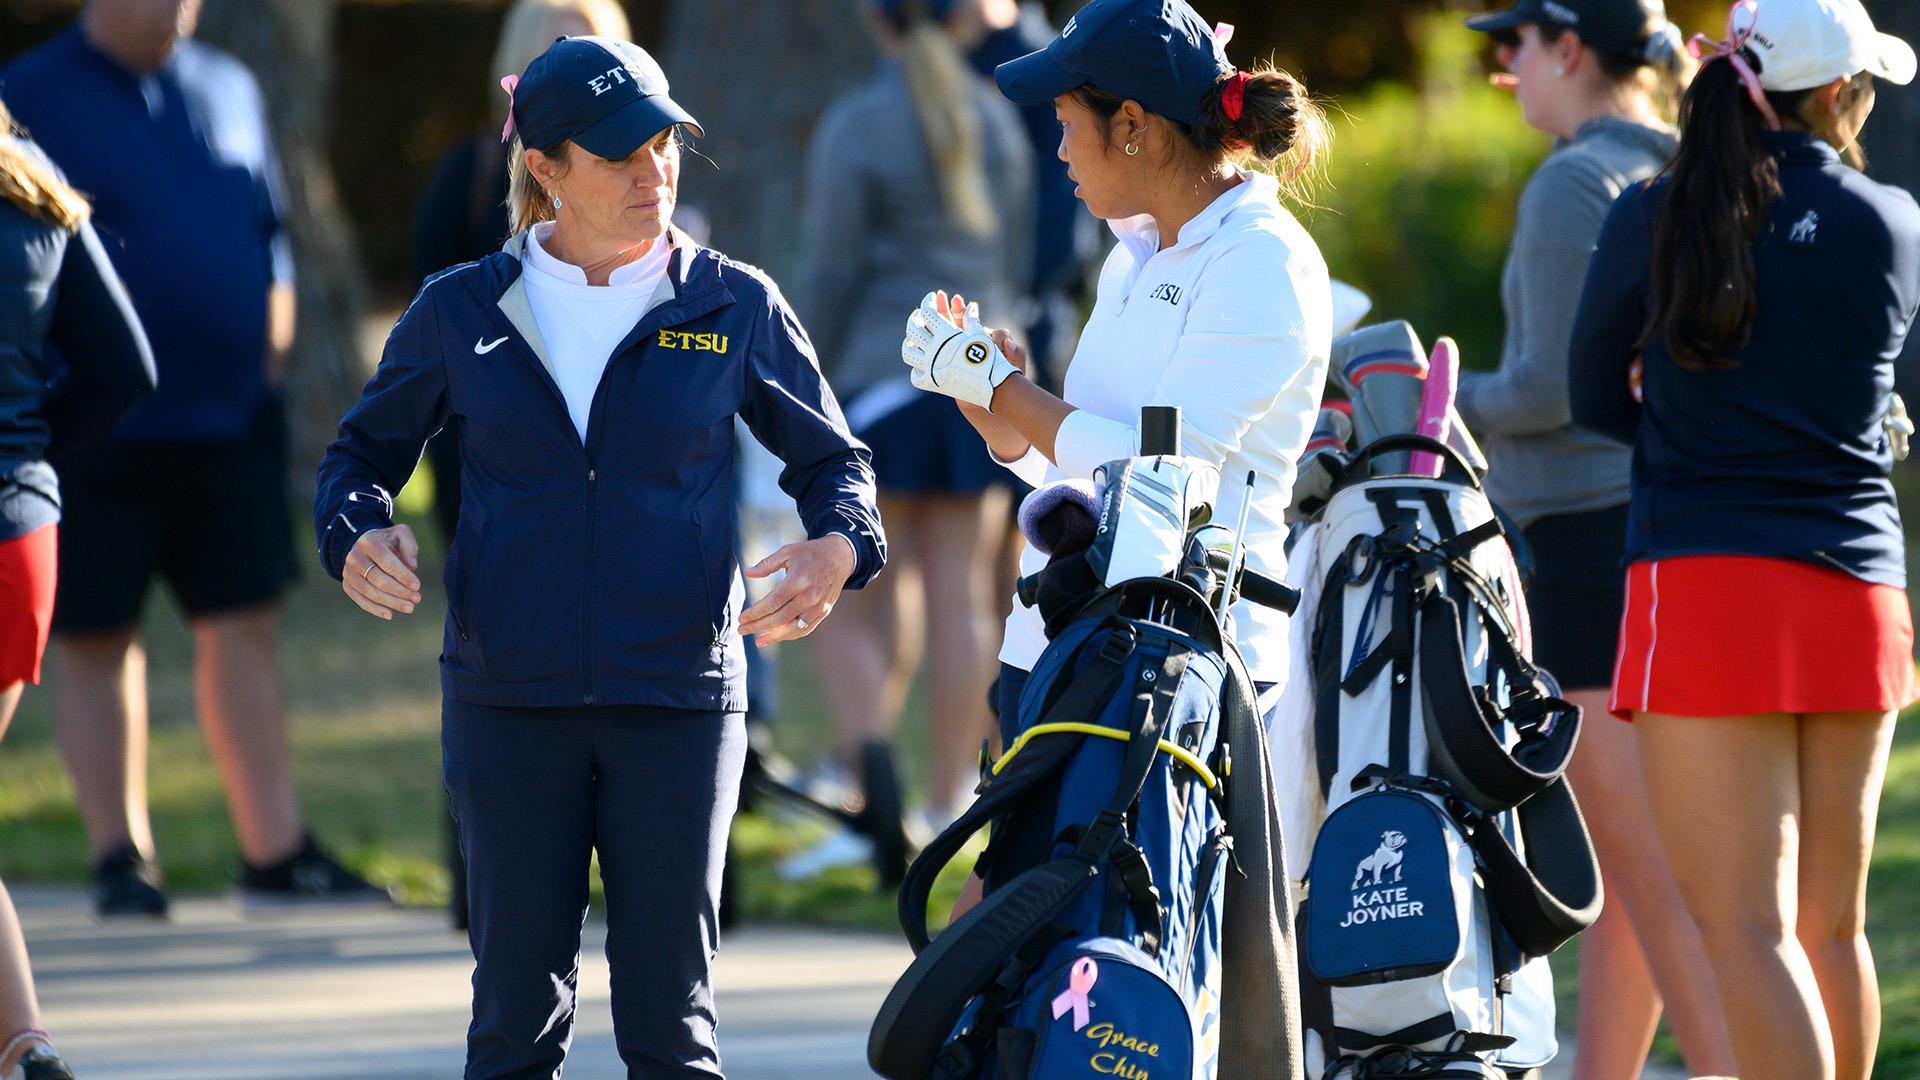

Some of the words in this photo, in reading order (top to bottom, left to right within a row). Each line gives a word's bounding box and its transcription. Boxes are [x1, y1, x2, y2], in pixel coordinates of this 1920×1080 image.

[1149, 283, 1184, 306] ETSU
[658, 329, 729, 354] ETSU
[1352, 887, 1408, 909] KATE
[1340, 901, 1424, 928] JOYNER
[1086, 1022, 1160, 1058] Grace
[1090, 1052, 1149, 1080] Chin
